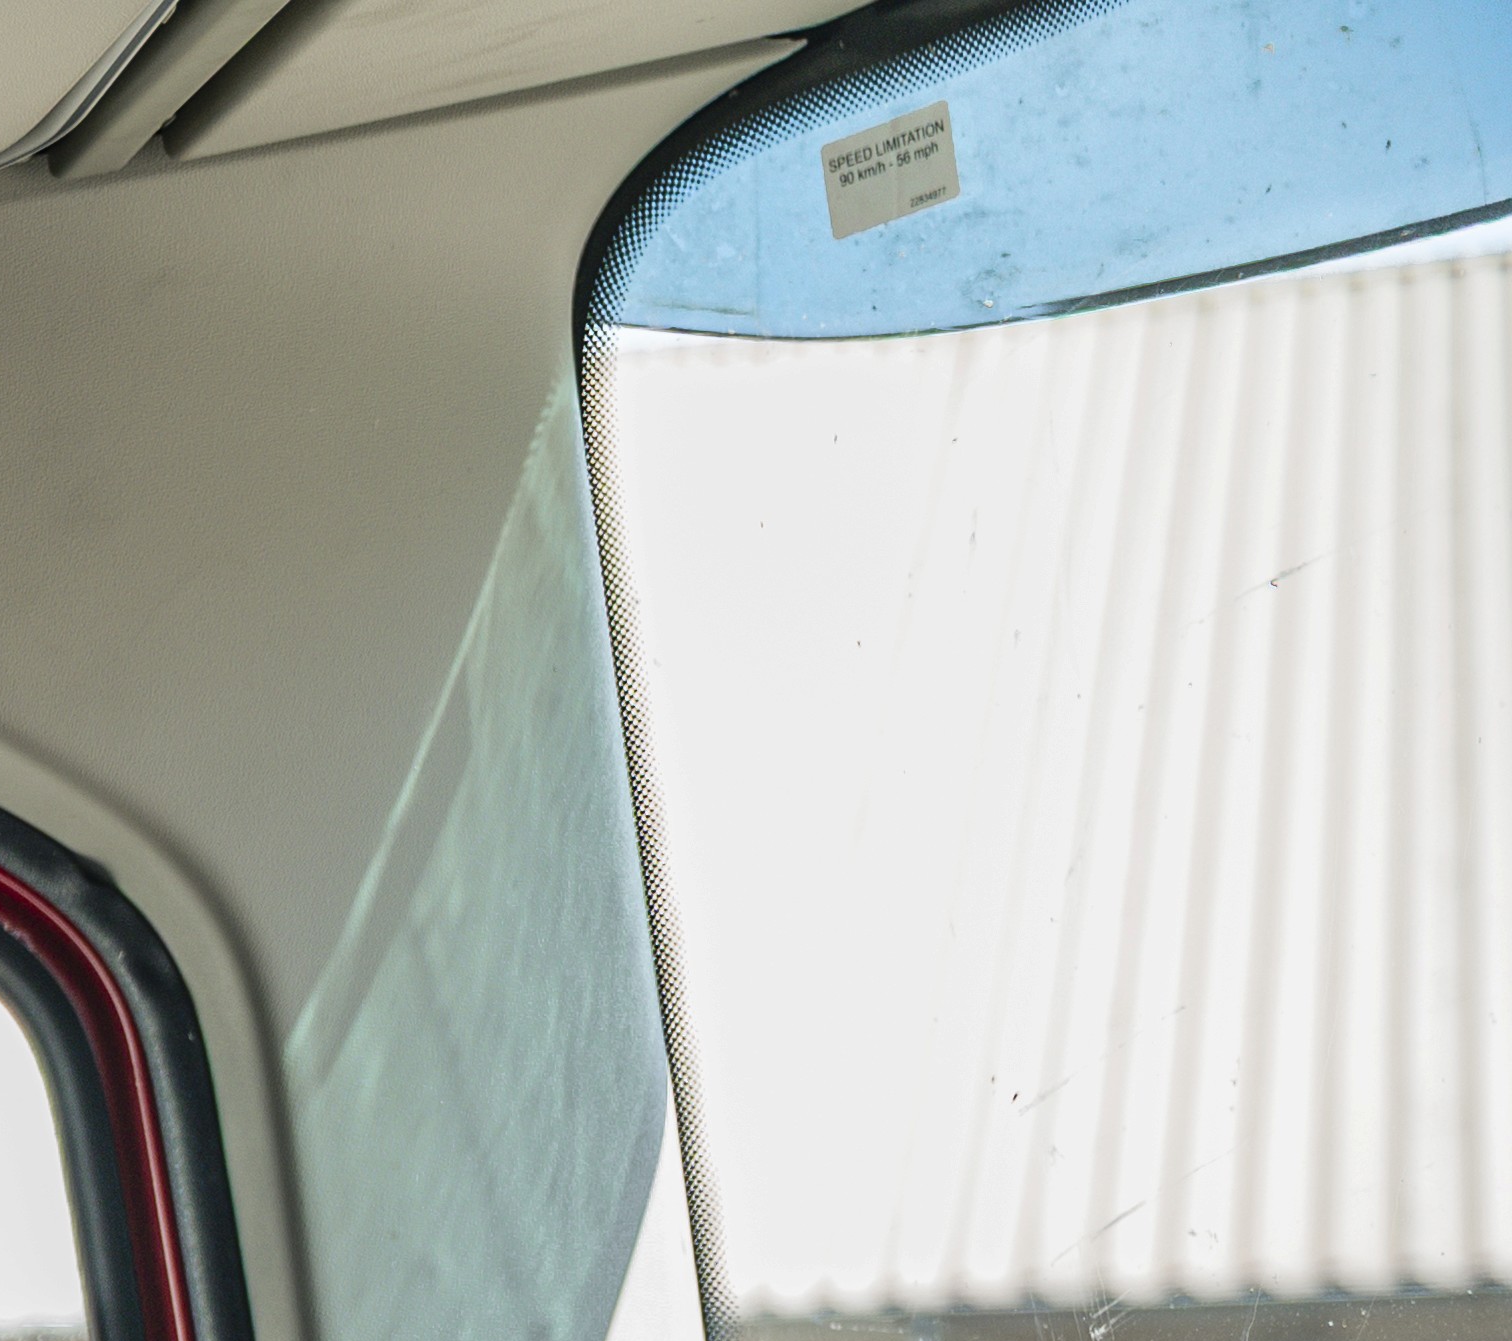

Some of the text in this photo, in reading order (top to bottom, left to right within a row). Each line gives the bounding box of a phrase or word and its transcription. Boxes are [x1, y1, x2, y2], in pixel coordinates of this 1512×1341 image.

[828, 119, 945, 173] SPEED LIMITATION
[839, 171, 855, 187] 90
[857, 161, 886, 181] km/h
[896, 150, 911, 167] 56
[913, 141, 939, 160] mph
